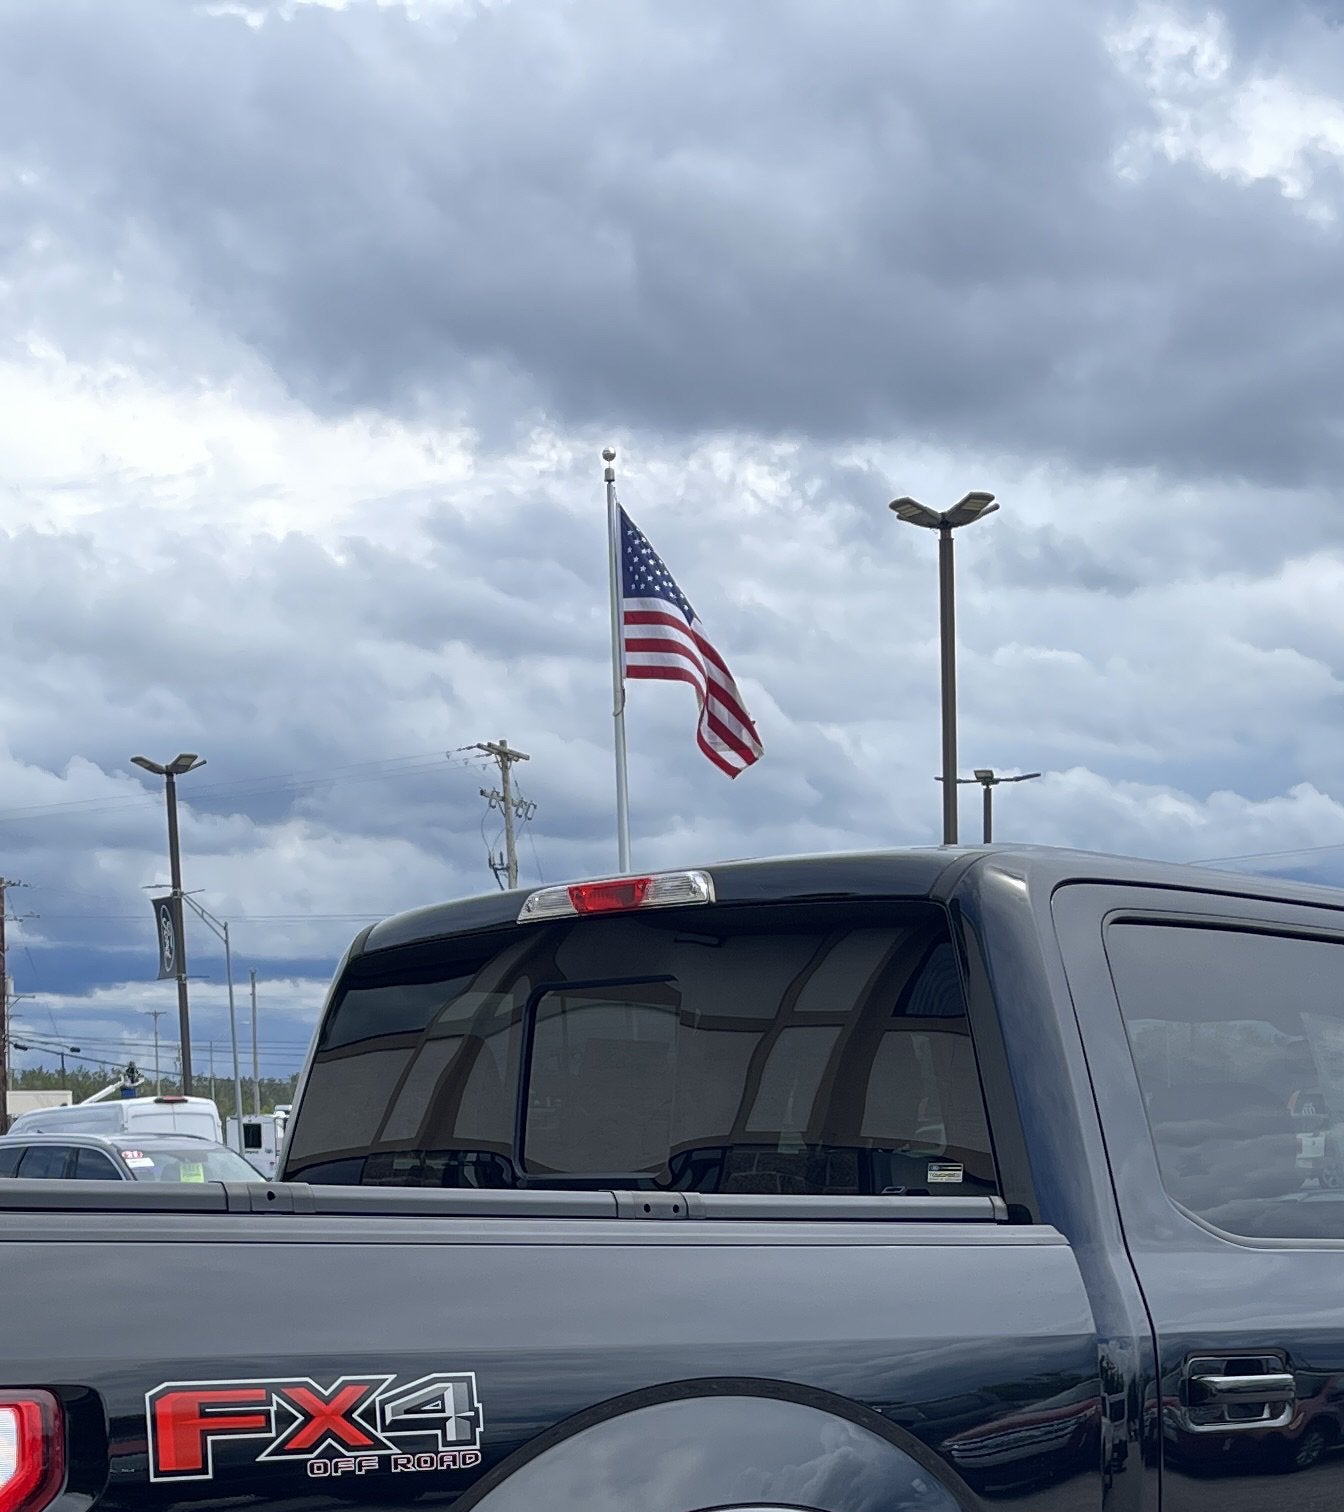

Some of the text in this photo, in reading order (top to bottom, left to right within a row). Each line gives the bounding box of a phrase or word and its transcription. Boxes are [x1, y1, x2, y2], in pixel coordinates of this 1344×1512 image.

[145, 1371, 484, 1482] FX4
[306, 1450, 482, 1478] OFF ROAD
